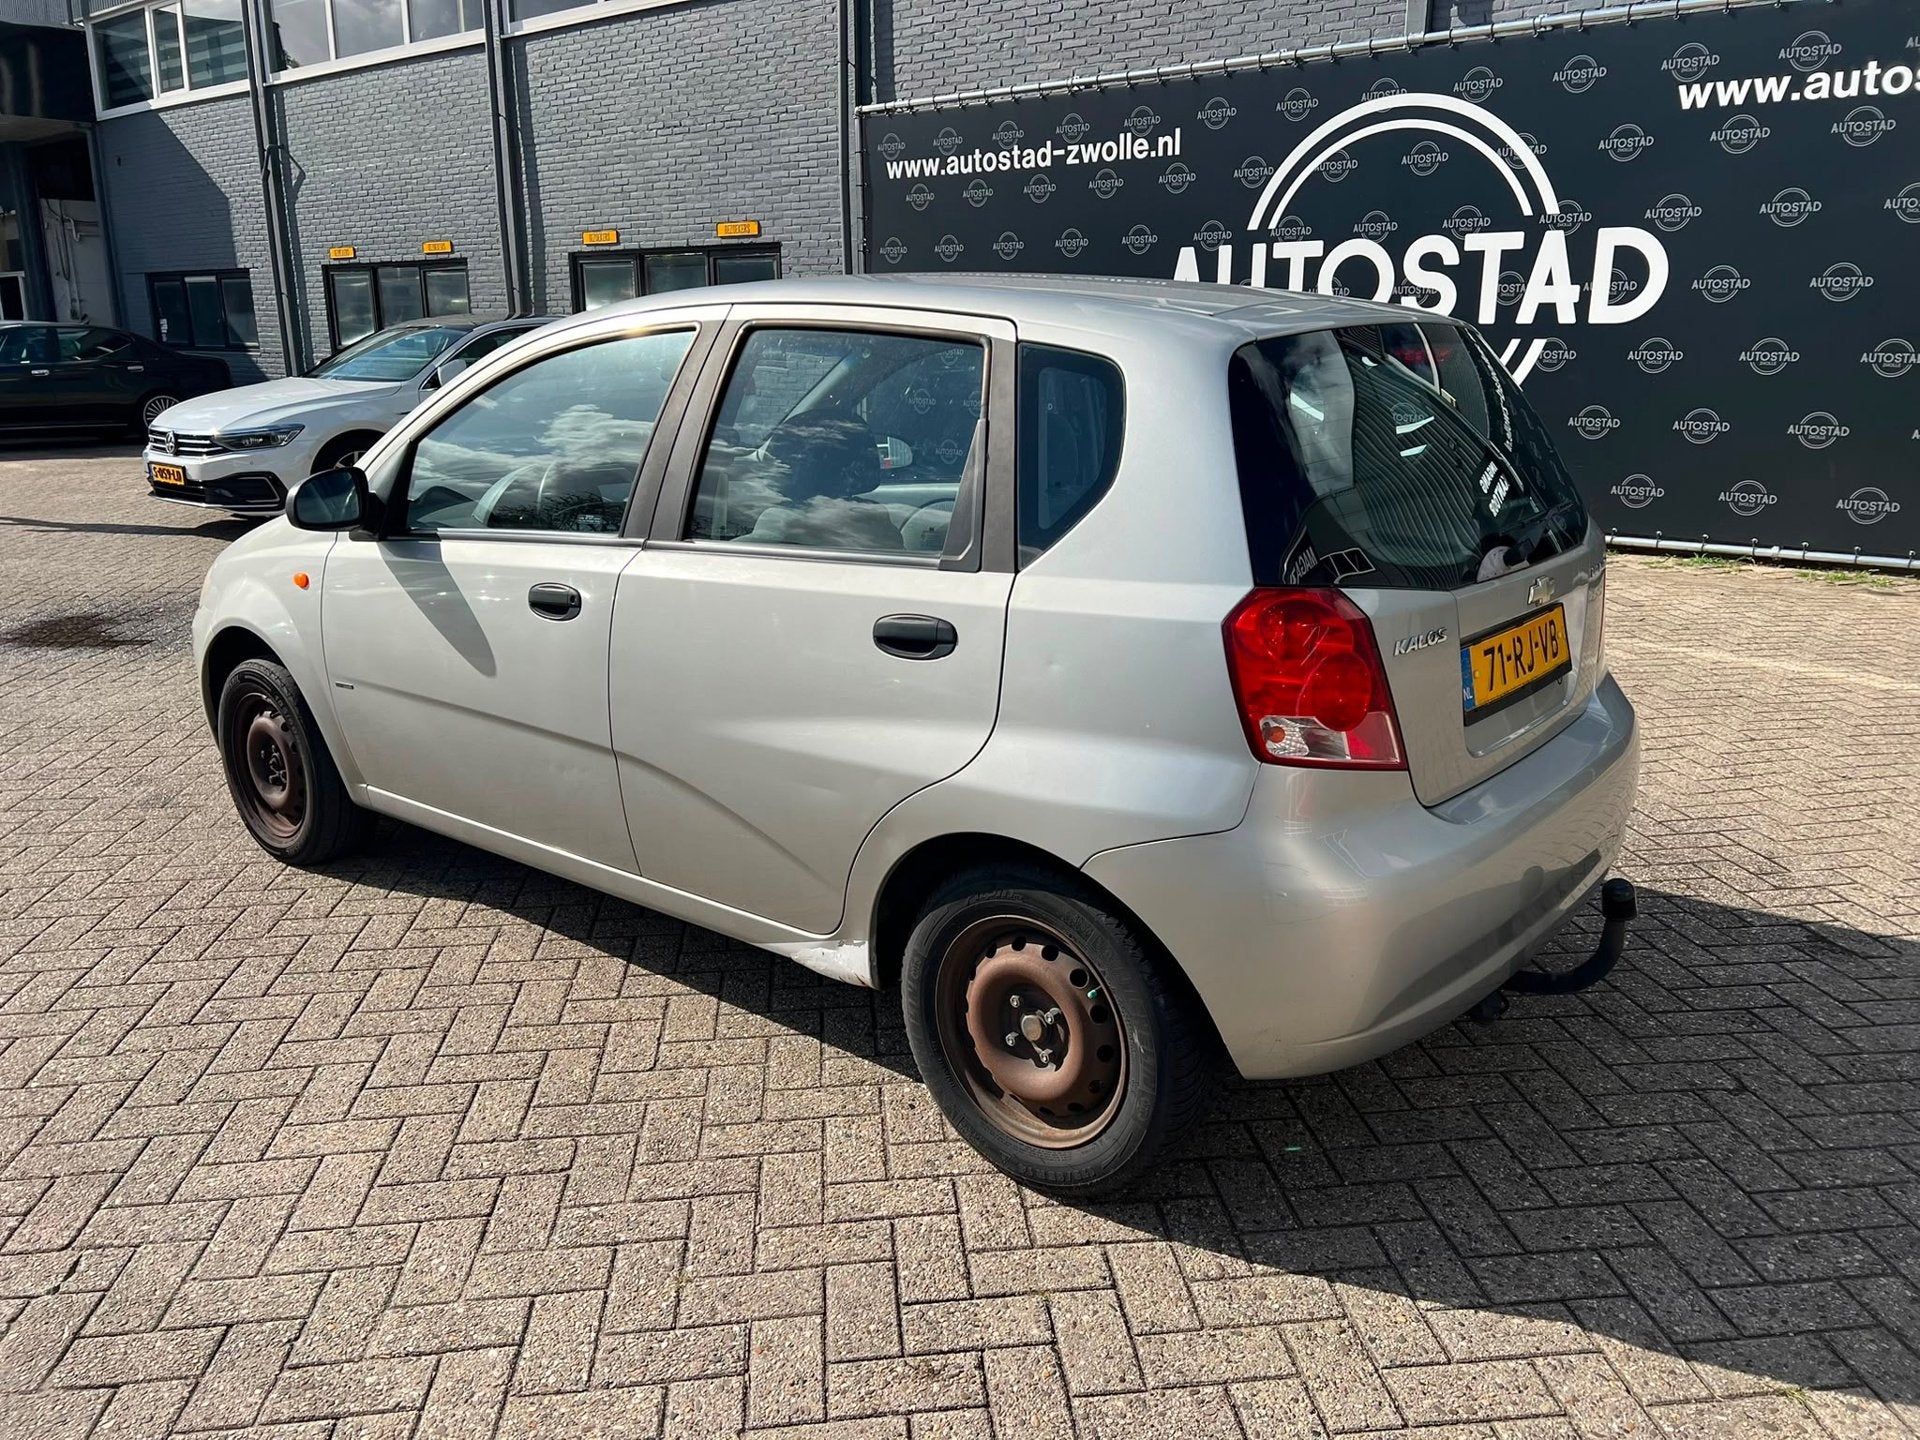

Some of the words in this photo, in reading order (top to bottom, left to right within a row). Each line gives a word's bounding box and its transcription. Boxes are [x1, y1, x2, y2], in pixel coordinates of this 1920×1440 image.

[1778, 43, 1842, 60] AUTOSTAD
[1661, 54, 1720, 71] AUTOSTAD
[1553, 66, 1607, 82] AUTOSTAD
[1453, 78, 1503, 93] AUTOSTAD
[1678, 60, 1920, 110] www.auto
[1276, 98, 1319, 112] AUTOSTAD
[1197, 106, 1237, 121] AUTOSTAD
[1124, 114, 1161, 128] AUTOSTAD
[1831, 119, 1896, 134] AUTOSTAD
[1056, 122, 1090, 135] AUTOSTAD
[1710, 127, 1771, 142] AUTOSTAD
[933, 135, 963, 147] AUTOSTAD
[992, 129, 1024, 142] AUTOSTAD
[878, 141, 906, 152] AUTOSTAD
[1598, 136, 1654, 150] AUTOSTAD
[886, 127, 1181, 180] www.autostad-zwolle.nl
[1401, 152, 1449, 165] AUTOSTAD
[1158, 172, 1196, 184] AUTOSTAD
[1233, 166, 1274, 179] AUTOSTAD
[1023, 182, 1057, 194] AUTOSTAD
[1088, 178, 1124, 190] AUTOSTAD
[906, 192, 935, 203] AUTOSTAD
[962, 188, 994, 199] AUTOSTAD
[1759, 201, 1822, 214] AUTOSTAD
[1884, 198, 1920, 209] AUTO
[1539, 212, 1592, 225] AUTOSTAD
[1645, 206, 1702, 220] AUTOSTAD
[1353, 221, 1398, 234] AUTOSTAD
[1442, 217, 1491, 230] AUTOSTAD
[1193, 228, 1232, 242] AUTOSTAD
[1270, 226, 1312, 237] AUTOSTAD
[993, 240, 1024, 251] AUTOSTAD
[1054, 238, 1089, 249] AUTOSTAD
[1122, 234, 1158, 246] AUTOSTAD
[880, 246, 908, 256] AUTOSTAD
[934, 242, 964, 254] AUTOSTAD
[1692, 278, 1751, 290] AUTOSTAD
[1810, 276, 1874, 289] AUTOSTAD
[1540, 350, 1577, 360] TOSTAD
[1627, 350, 1684, 362] AUTOSTAD
[1739, 350, 1800, 362] AUTOSTAD
[1568, 417, 1620, 429] AUTOSTAD
[1672, 420, 1730, 432] AUTOSTAD
[1787, 424, 1850, 438] AUTOSTAD
[1610, 485, 1665, 498] AUTOSTAD
[1718, 492, 1778, 506] AUTOSTAD
[1836, 500, 1900, 513] AUTOSTAD
[1393, 626, 1448, 657] KALOS
[1483, 619, 1559, 693] 71-RJ-VB
[1463, 686, 1474, 700] NL
